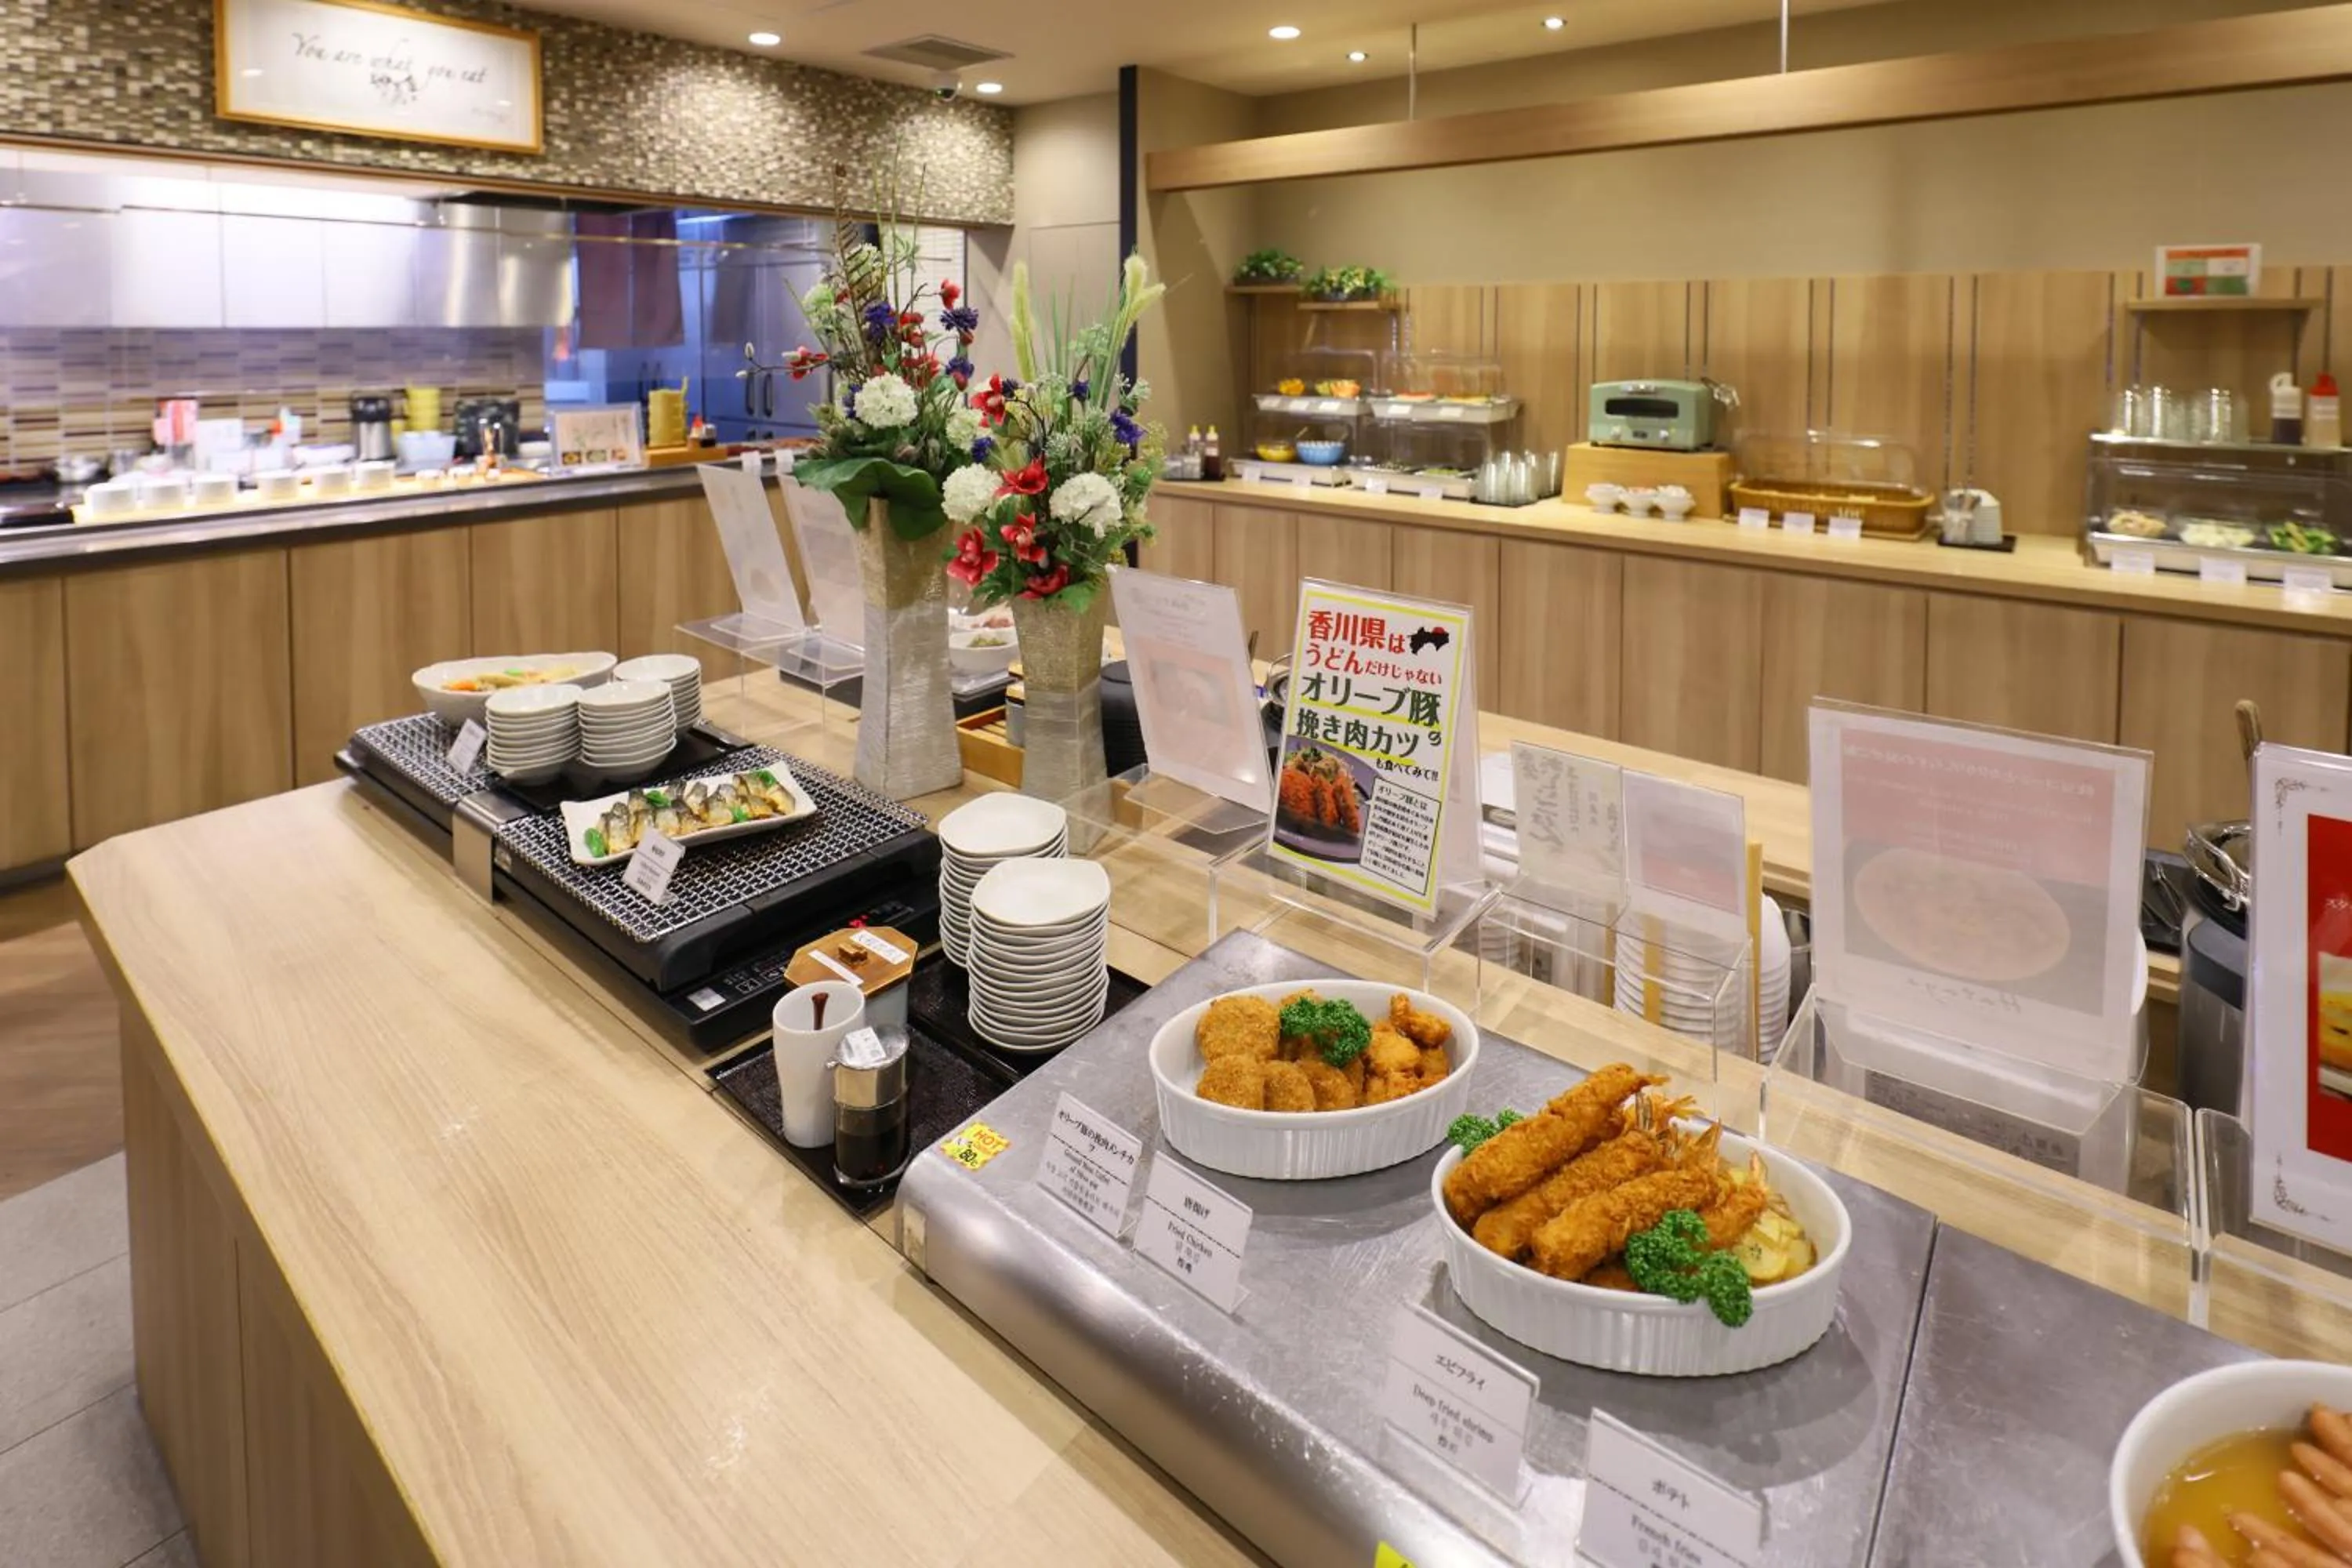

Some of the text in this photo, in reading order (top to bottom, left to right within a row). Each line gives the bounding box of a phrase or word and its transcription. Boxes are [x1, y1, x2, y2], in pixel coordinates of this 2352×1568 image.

[292, 32, 326, 60] You
[333, 50, 363, 64] are
[1308, 611, 1406, 654] 香川県は
[1306, 642, 1443, 684] うどんだけじゃない
[1301, 672, 1442, 727] オリーブ豚
[974, 1129, 1004, 1149] HOT
[1435, 1354, 1486, 1392] エビフライ
[1413, 1384, 1436, 1407] Deep
[1438, 1399, 1461, 1423] fried
